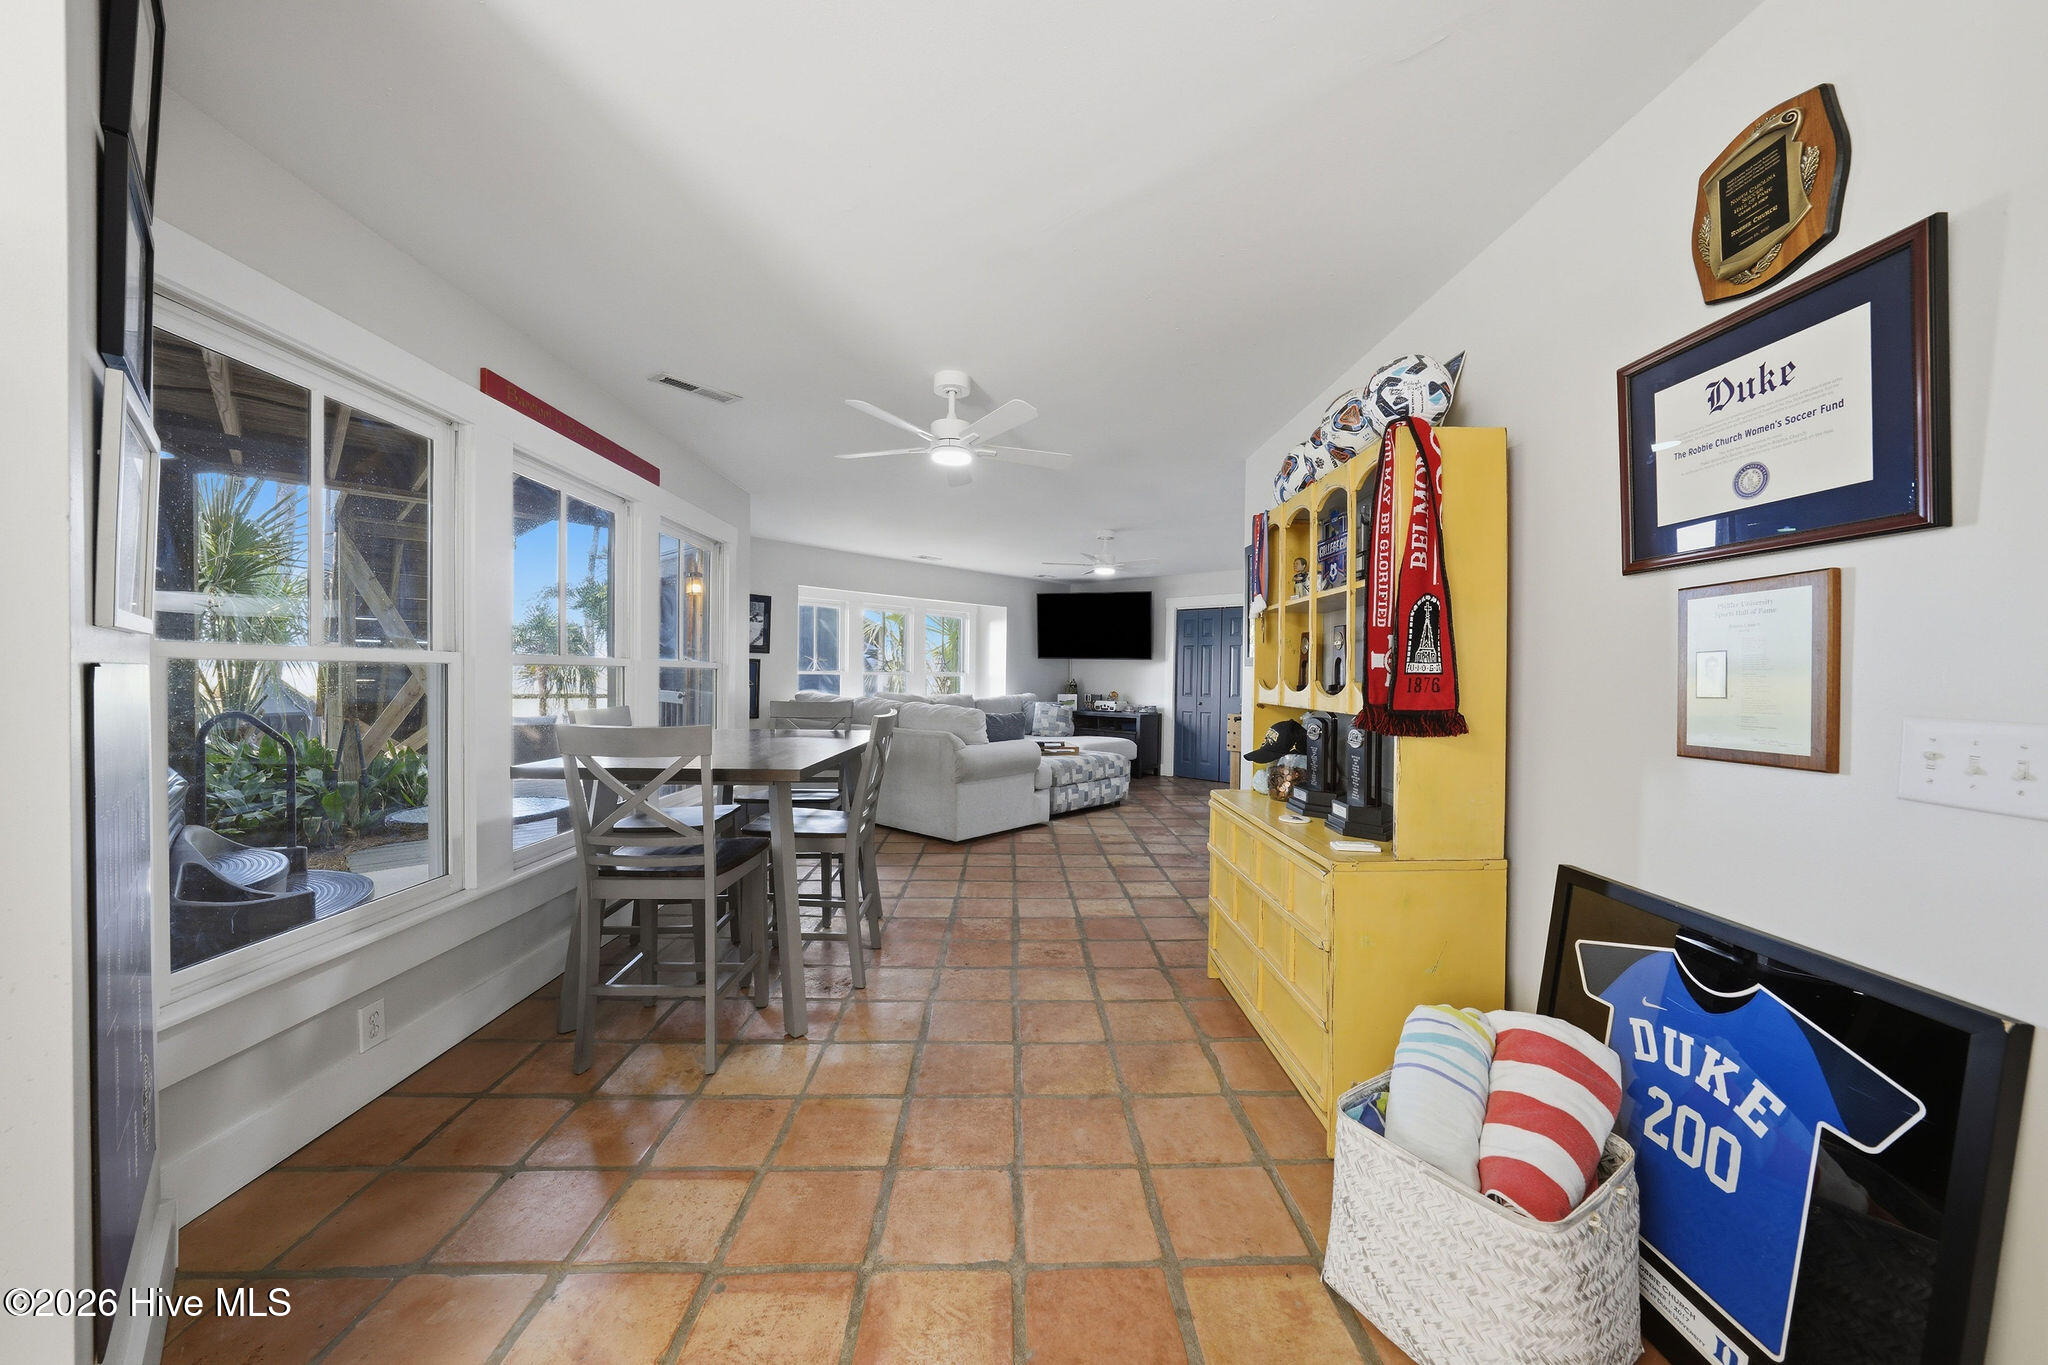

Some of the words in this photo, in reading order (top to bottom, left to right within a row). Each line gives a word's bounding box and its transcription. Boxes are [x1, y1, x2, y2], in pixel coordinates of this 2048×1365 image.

[1752, 204, 1778, 224] CHURCH
[1705, 360, 1797, 415] Duke
[1673, 452, 1687, 461] The
[1688, 443, 1714, 456] Robbie
[1715, 432, 1743, 448] Church
[1744, 419, 1782, 438] Women's
[1785, 407, 1818, 426] Soccer
[1820, 399, 1845, 414] Fund
[1381, 466, 1392, 506] MAY
[1380, 511, 1390, 534] BE
[1377, 538, 1389, 628] GLORIFIED
[1407, 676, 1441, 693] 1876
[1629, 1017, 1788, 1140] DUKE
[1643, 1085, 1743, 1195] 200
[1657, 1298, 1672, 1315] DUKE
[1672, 1312, 1706, 1346] UNIVERSITY
[1662, 1285, 1696, 1321] CHURCH
[1674, 1307, 1690, 1322] 2017
